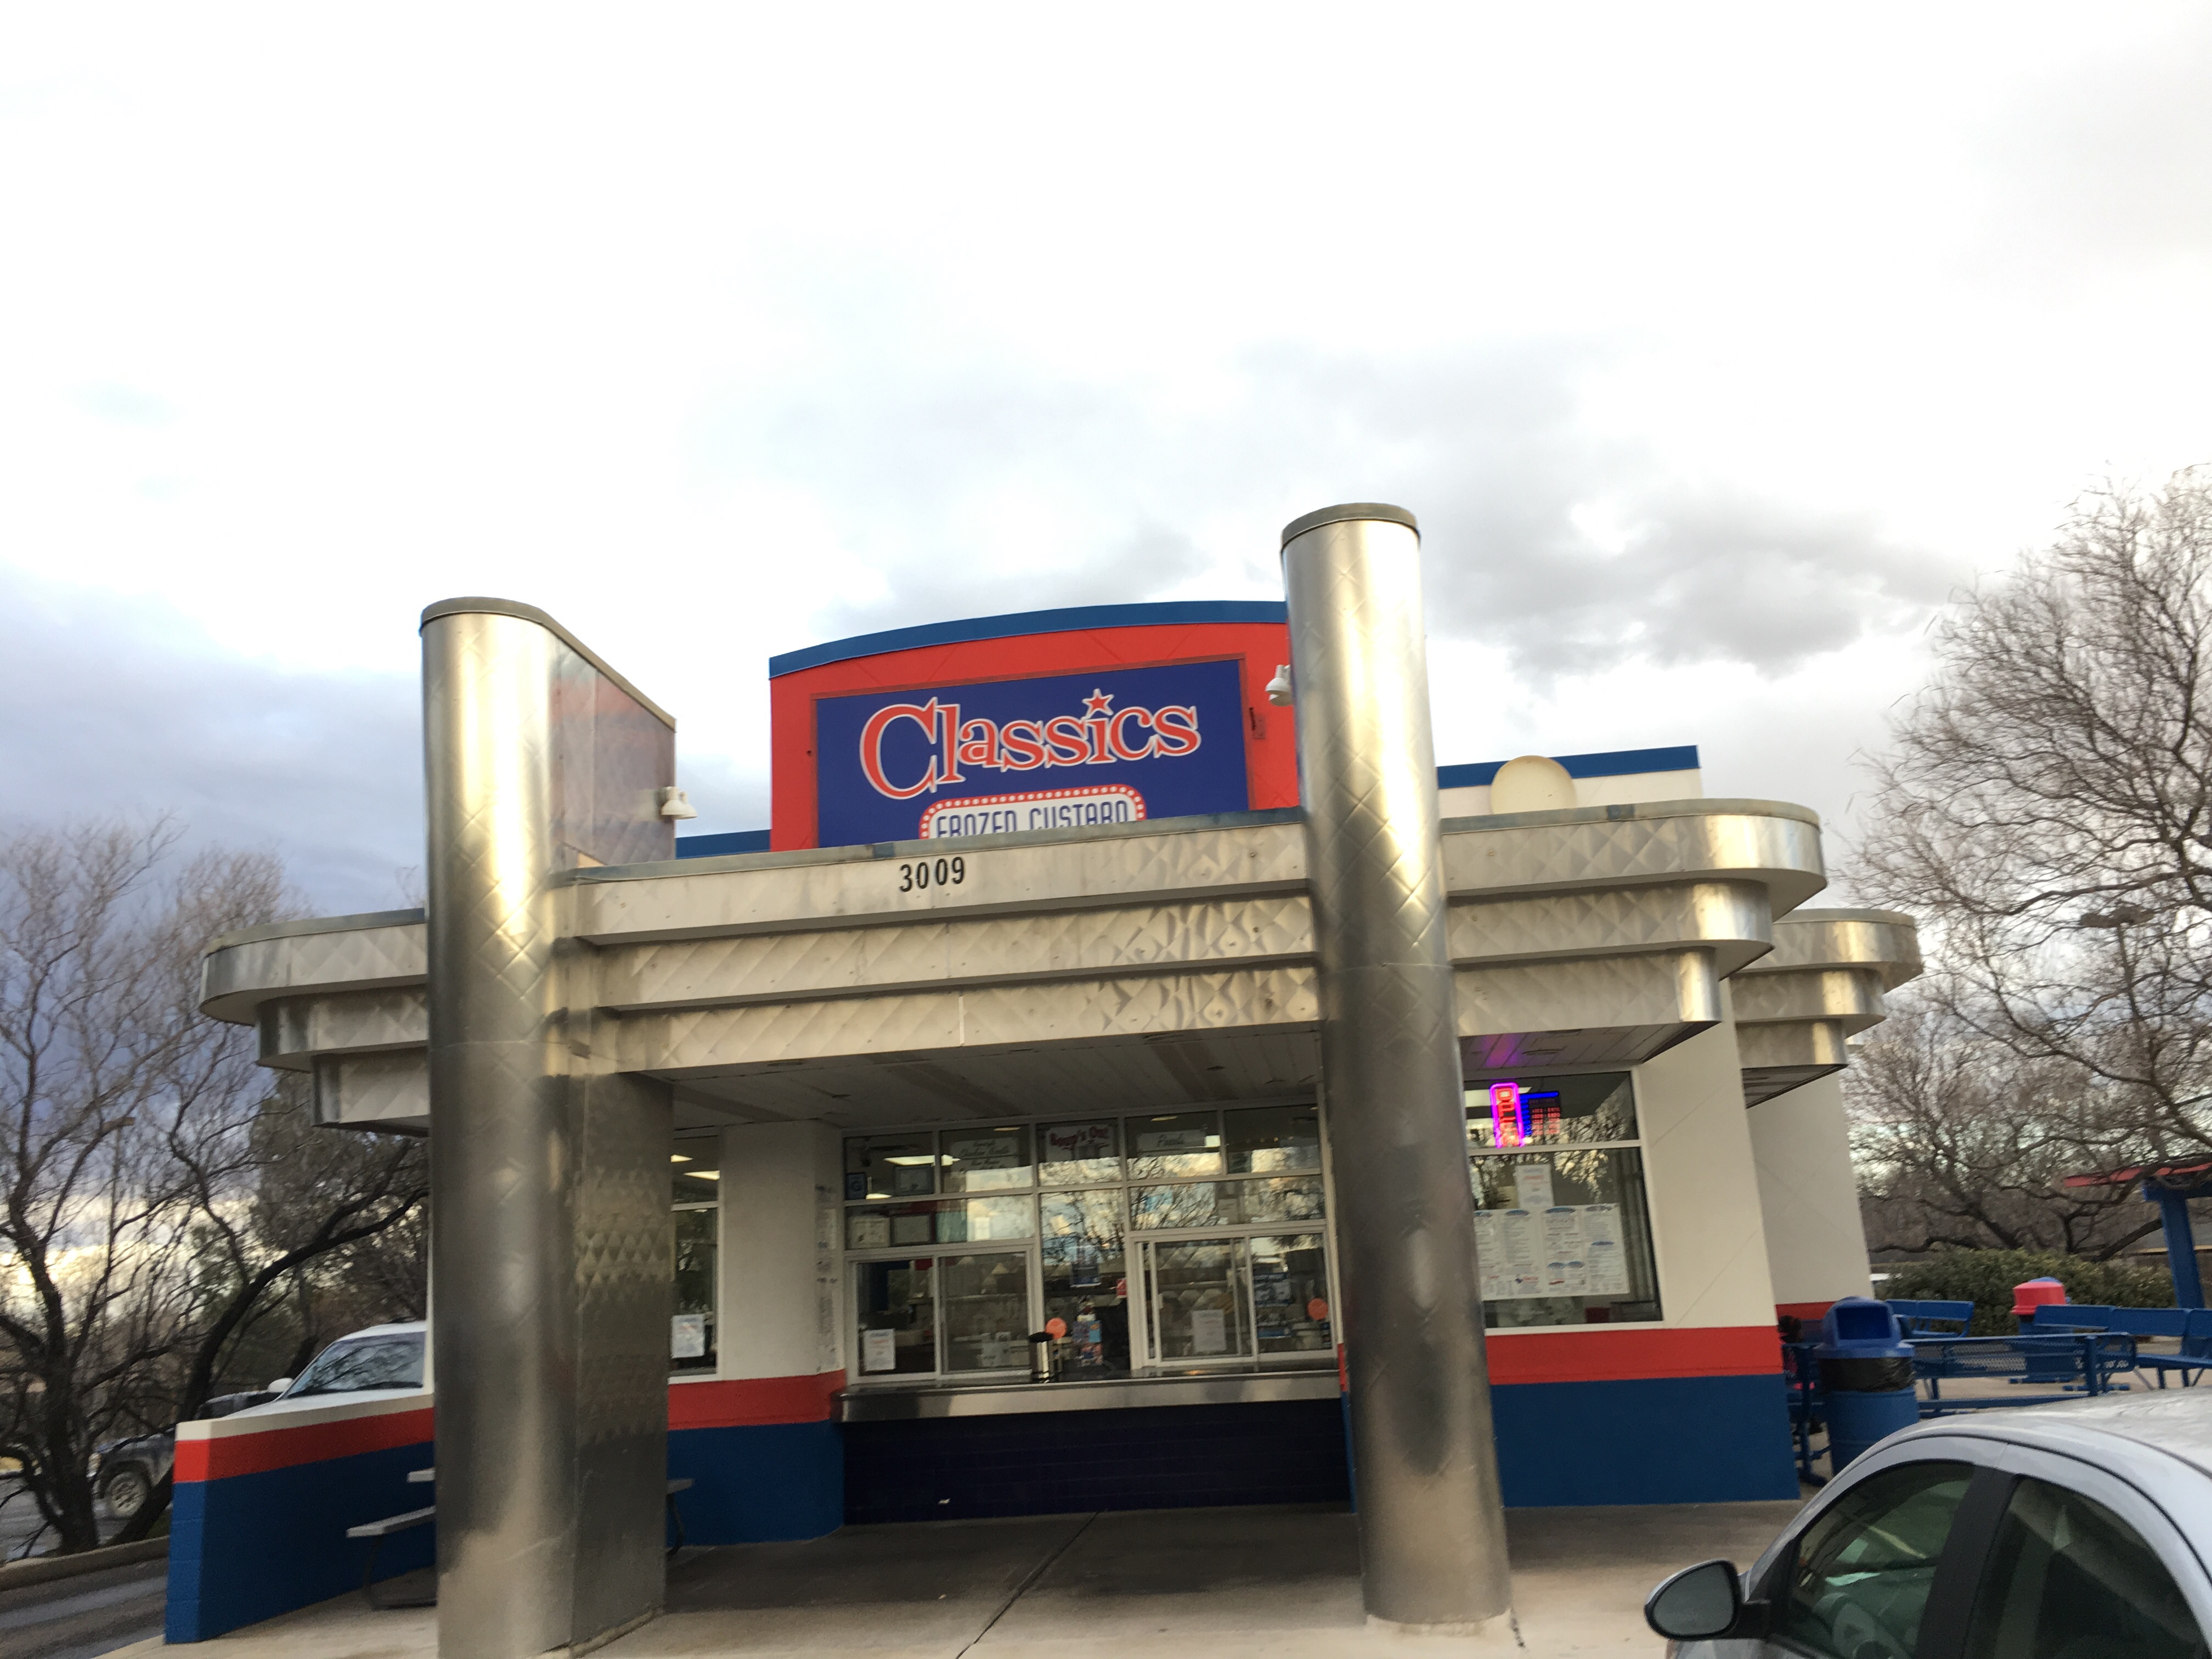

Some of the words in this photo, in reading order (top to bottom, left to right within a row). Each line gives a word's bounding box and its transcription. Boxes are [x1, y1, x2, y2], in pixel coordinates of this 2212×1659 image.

[860, 688, 1201, 800] Classics
[937, 809, 1018, 838] FROZEN
[1029, 799, 1128, 830] CUSTARD
[899, 856, 965, 893] 3009
[1496, 1087, 1520, 1147] OPEN
